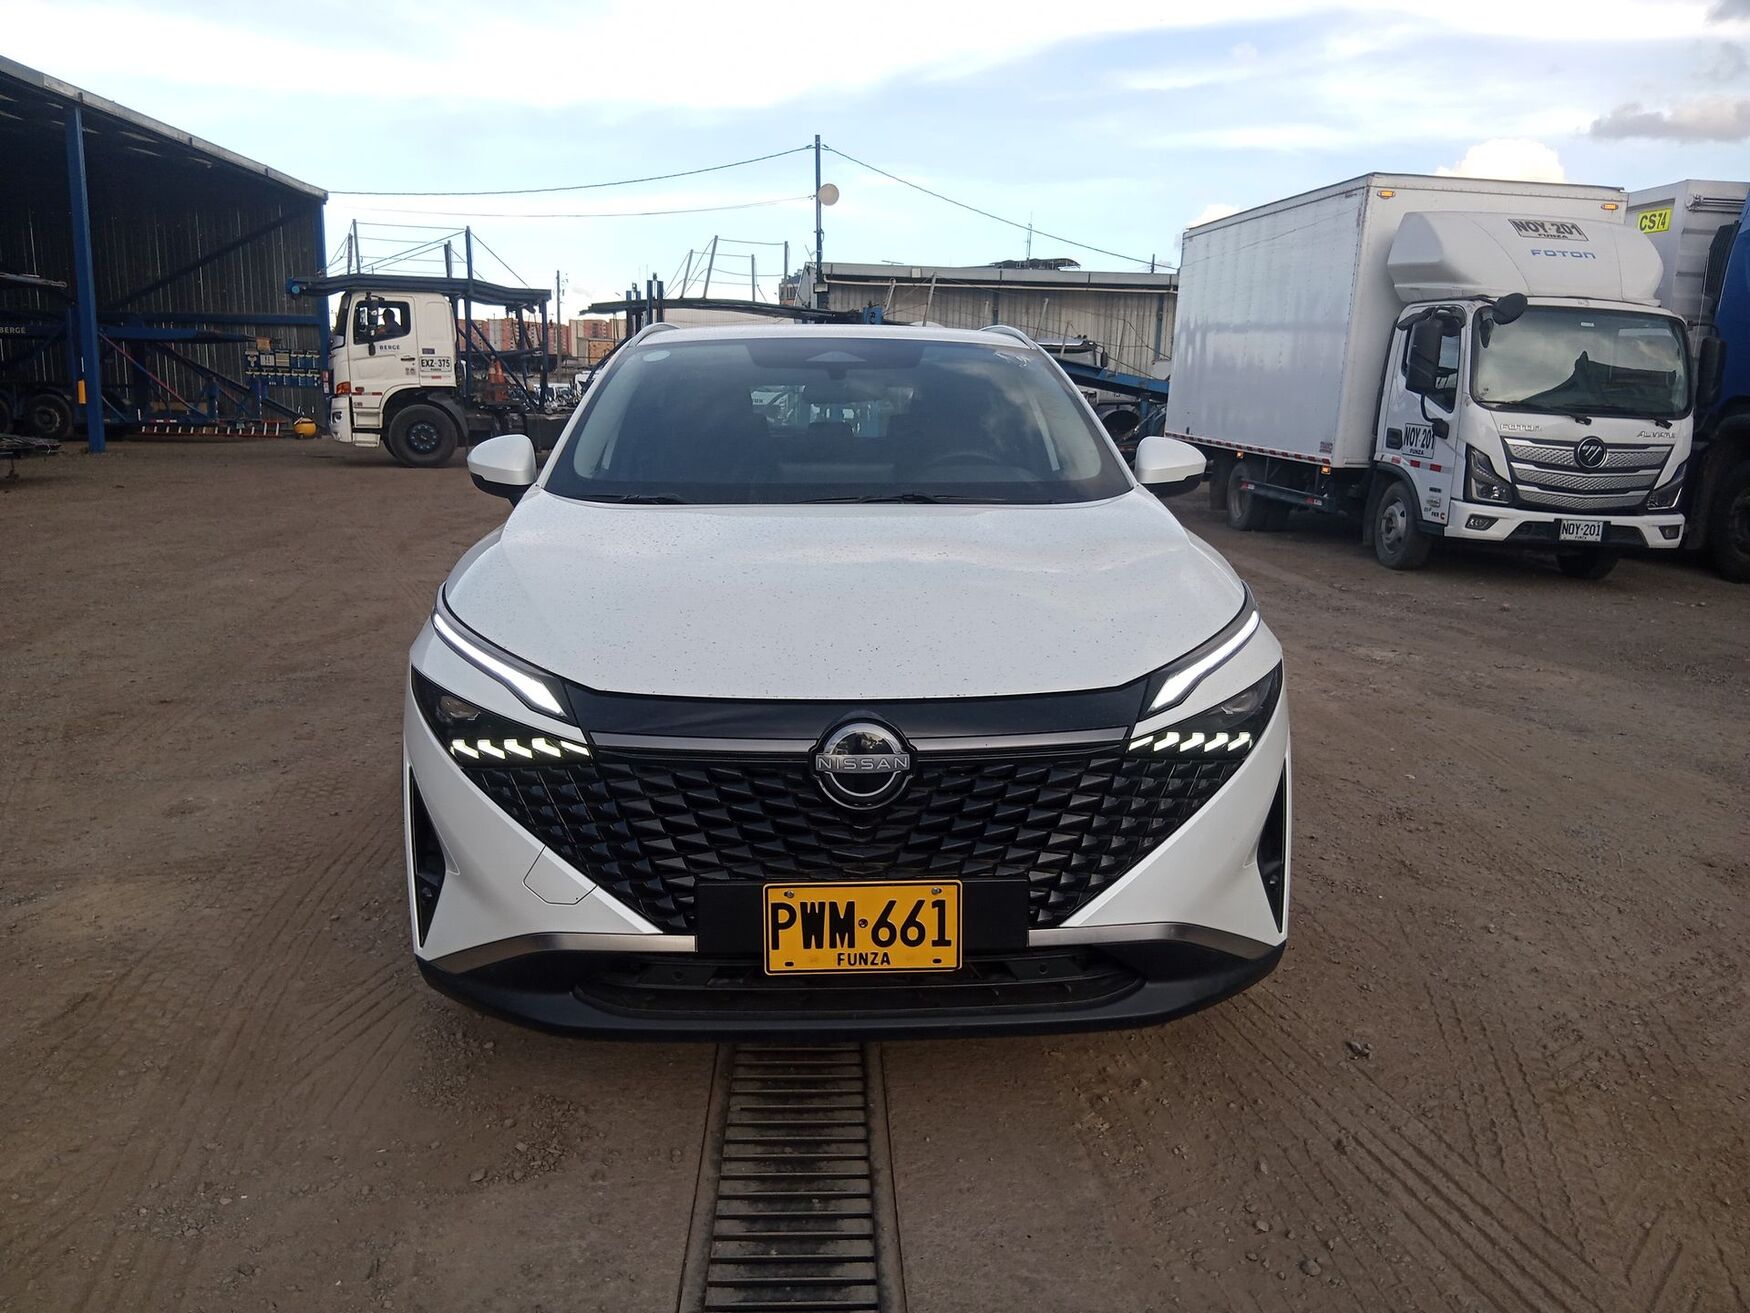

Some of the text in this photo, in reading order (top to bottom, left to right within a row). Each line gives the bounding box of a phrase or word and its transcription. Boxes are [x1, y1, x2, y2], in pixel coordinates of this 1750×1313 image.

[1639, 212, 1668, 231] CS74
[1530, 249, 1597, 260] FOTON
[818, 756, 908, 770] NISSAN
[837, 952, 890, 966] FUNZA
